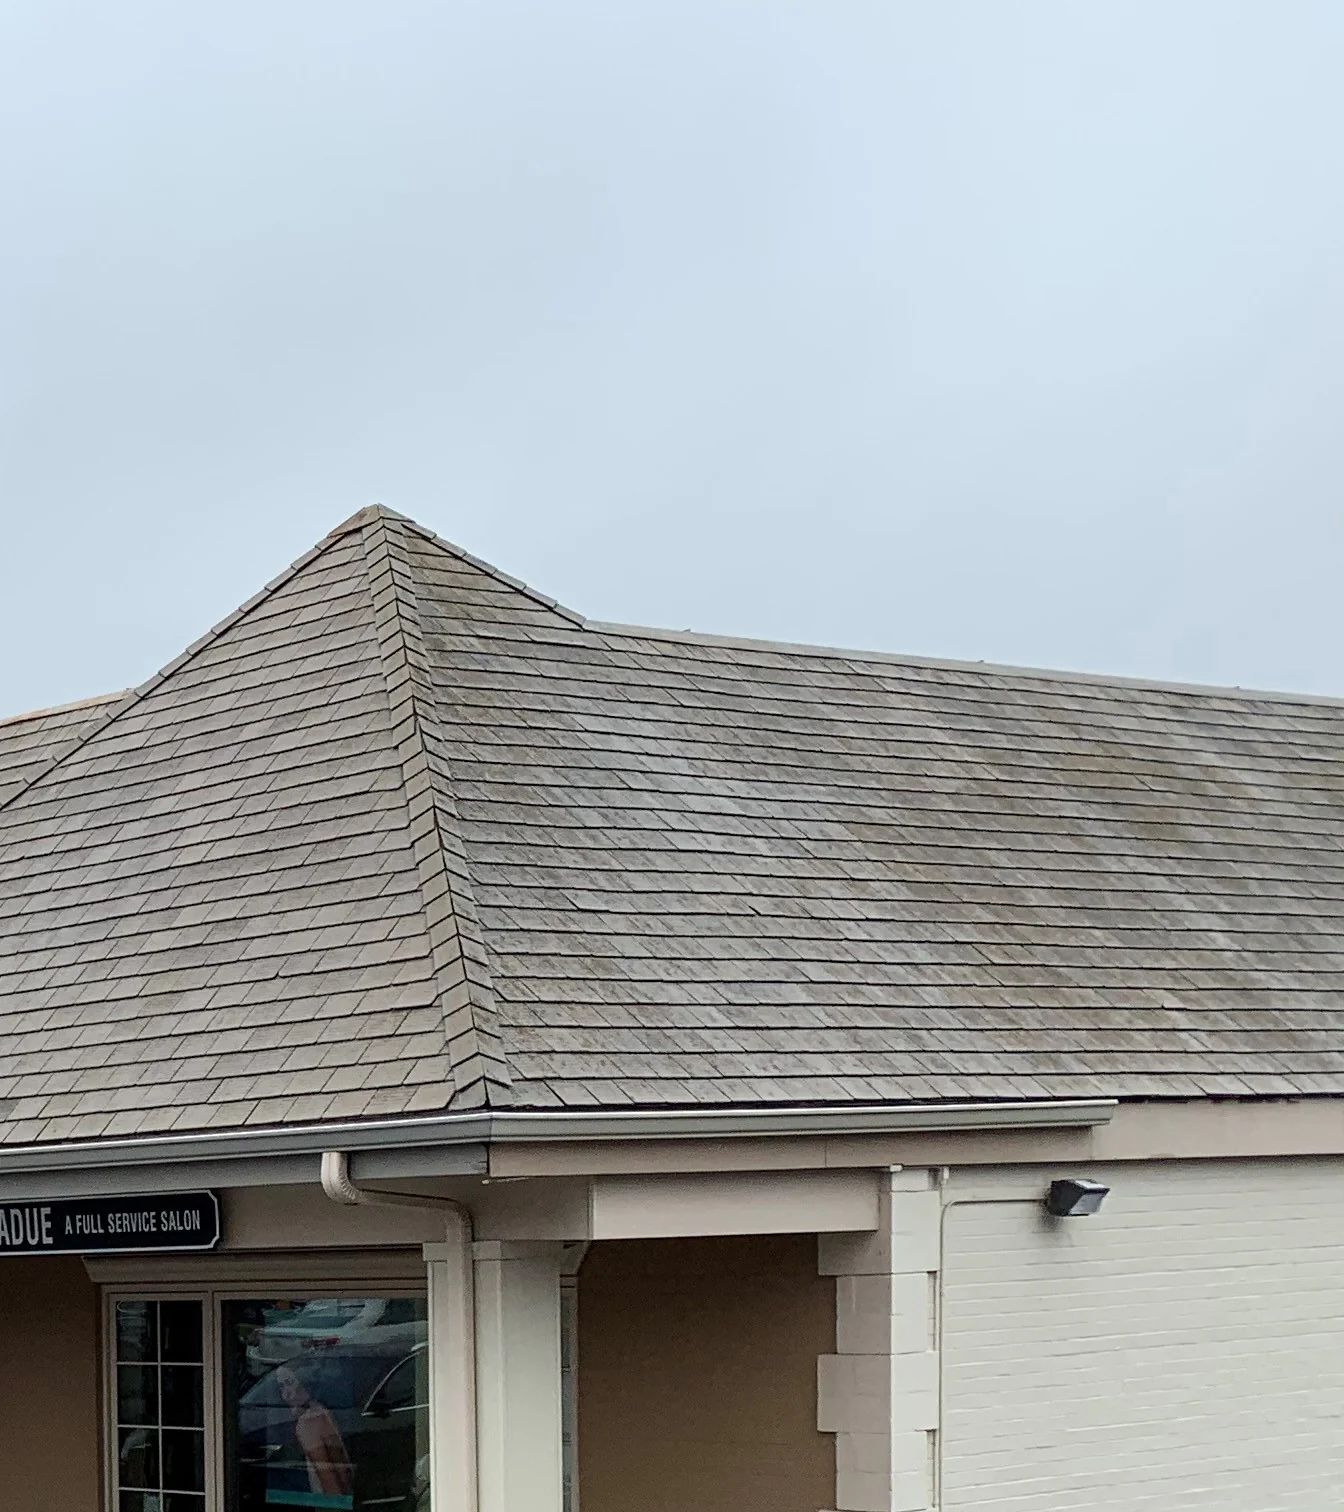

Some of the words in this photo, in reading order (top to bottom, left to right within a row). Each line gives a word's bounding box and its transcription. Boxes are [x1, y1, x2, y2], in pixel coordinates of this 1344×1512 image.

[65, 1220, 72, 1235] A
[76, 1217, 104, 1236] FULL
[107, 1213, 157, 1234] SERVICE
[160, 1209, 201, 1231] SALON
